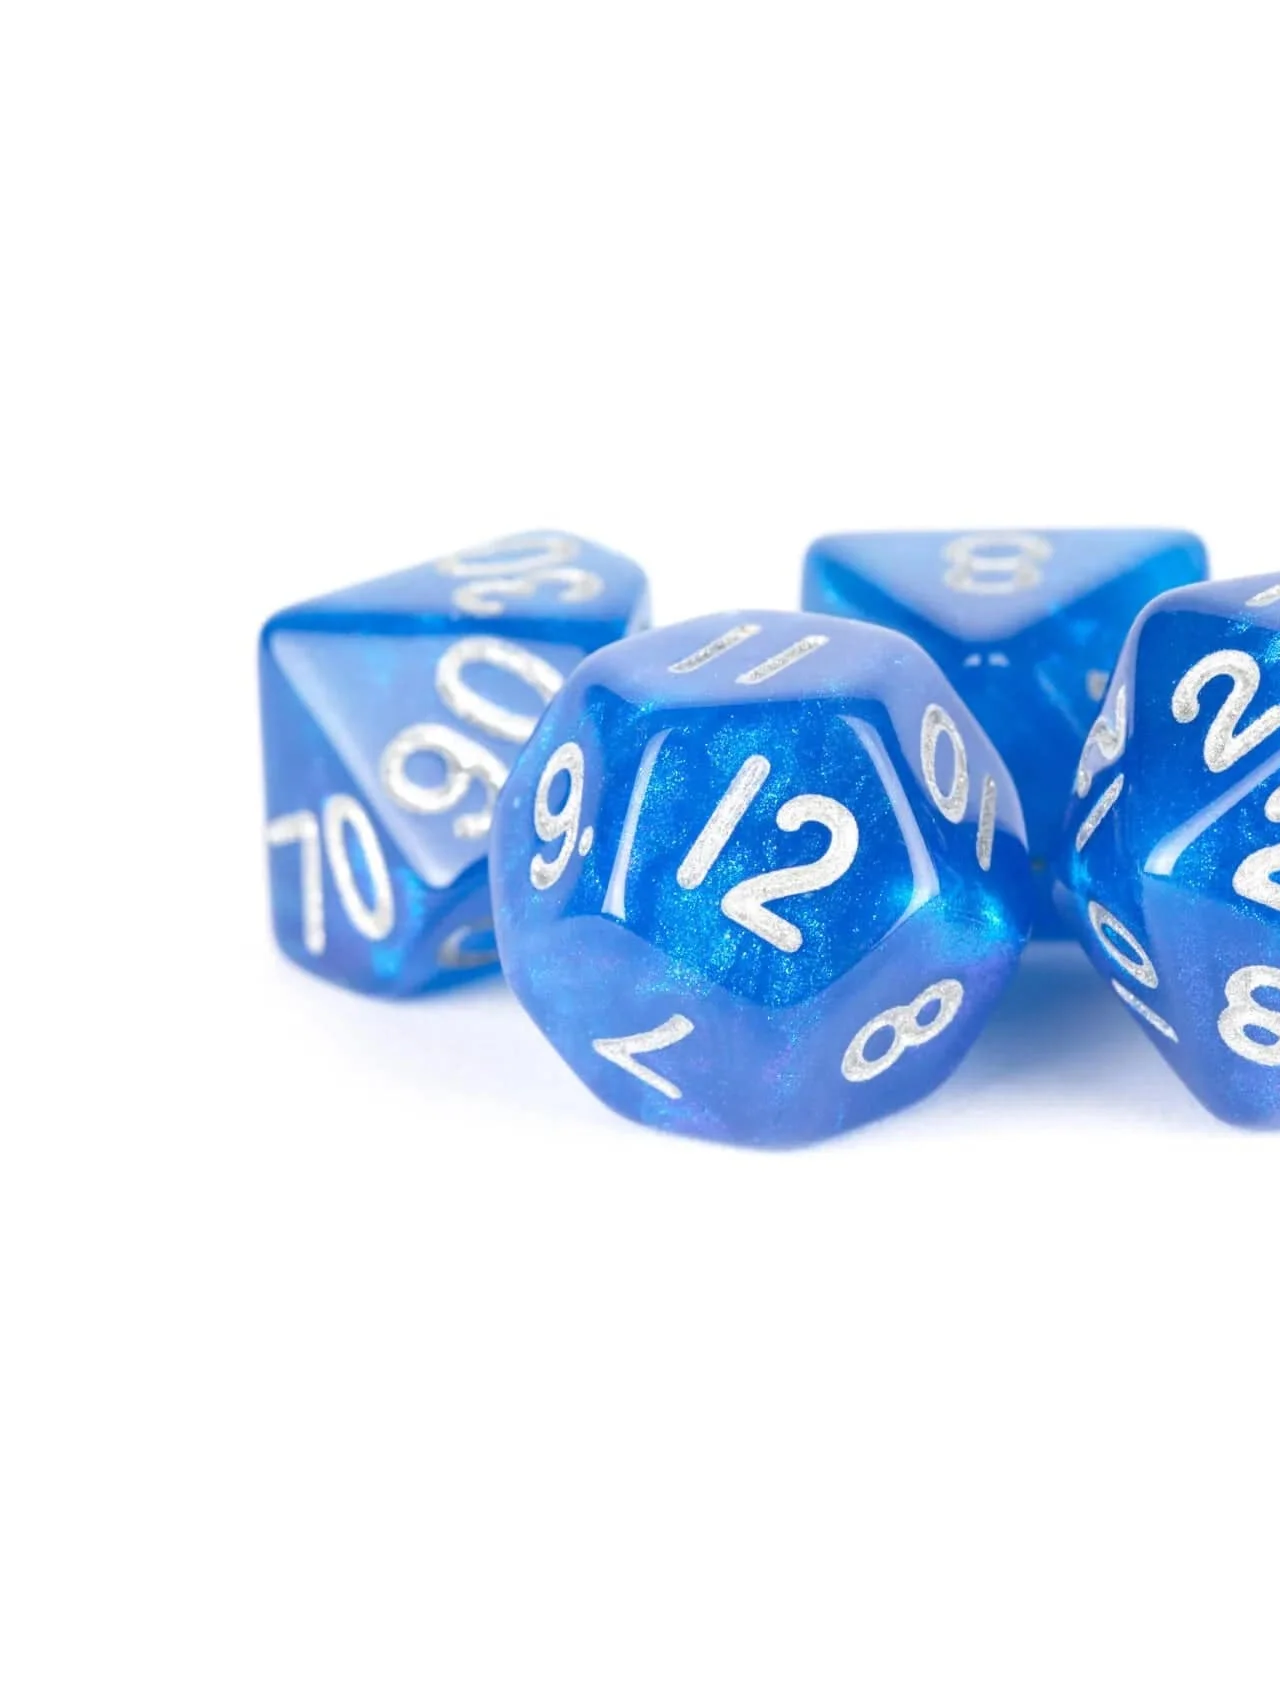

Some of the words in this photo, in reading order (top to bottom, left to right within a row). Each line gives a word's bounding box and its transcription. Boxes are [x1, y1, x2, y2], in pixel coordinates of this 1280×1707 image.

[437, 535, 602, 617] 30
[942, 532, 1053, 595] 8
[667, 623, 830, 684] 11
[380, 635, 566, 839] 90
[919, 703, 996, 872] 10
[266, 793, 395, 956] 70
[676, 754, 860, 953] 12
[840, 978, 964, 1082] 8
[1088, 899, 1180, 1043] 10
[592, 1013, 695, 1099] 7
